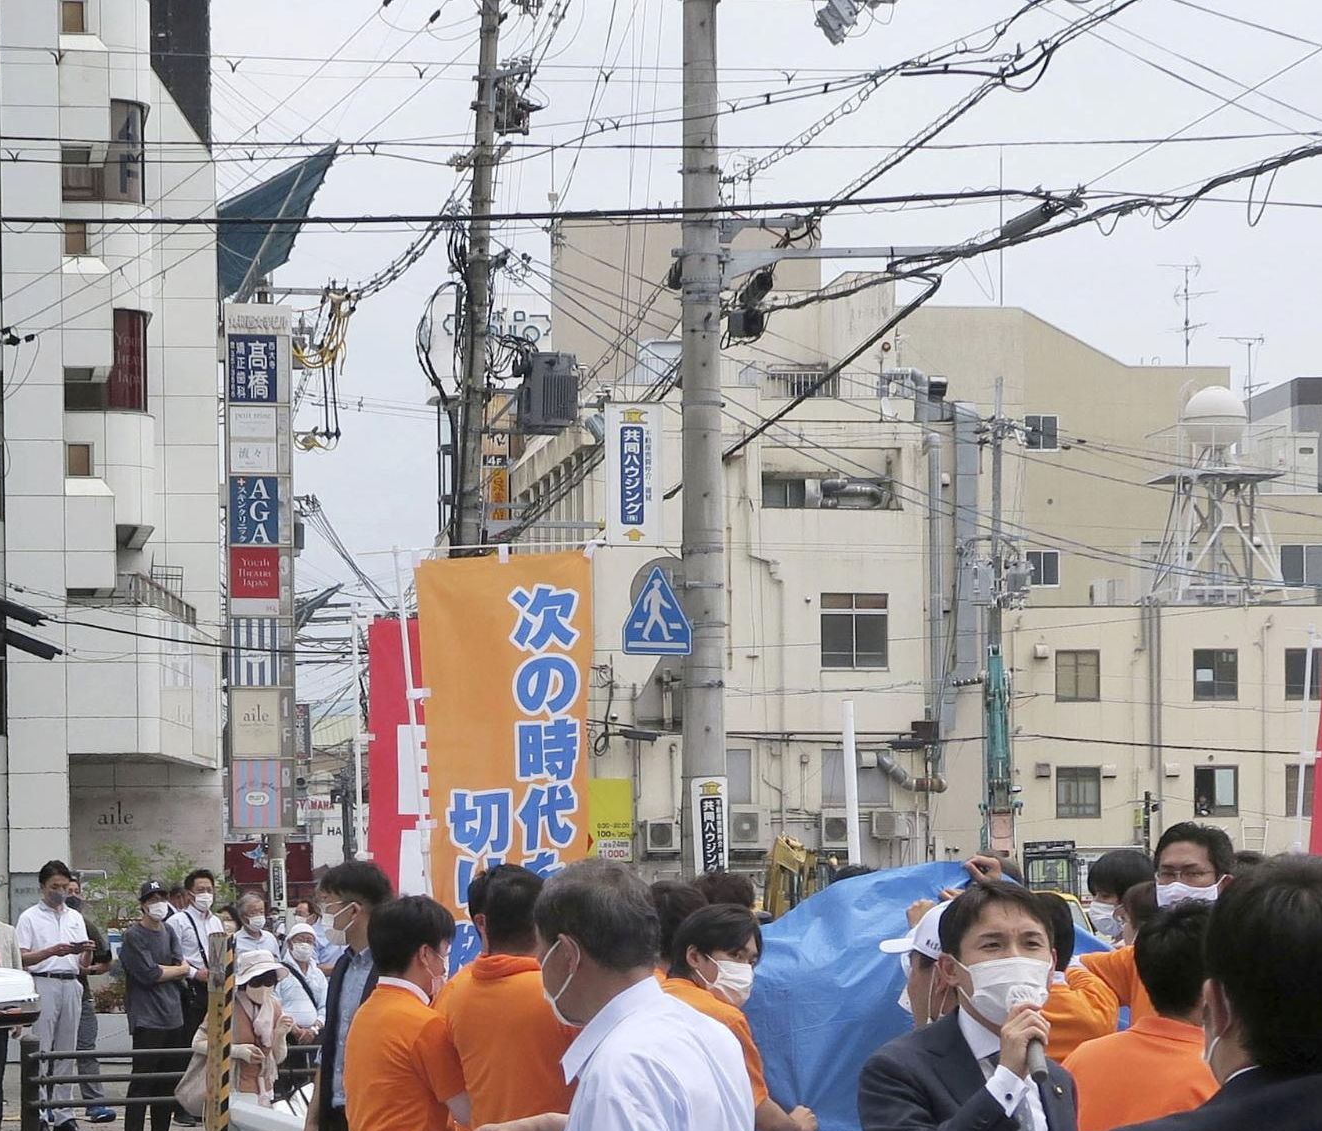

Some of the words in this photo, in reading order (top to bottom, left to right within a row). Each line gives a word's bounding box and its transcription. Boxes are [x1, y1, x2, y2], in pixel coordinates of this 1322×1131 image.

[236, 341, 245, 399] 矯正歯科
[488, 456, 502, 466] 4F
[237, 486, 247, 543] スキンクリニック
[249, 478, 272, 544] AGA
[243, 704, 269, 722] aile
[282, 697, 291, 743] 1F
[97, 800, 134, 825] aile
[703, 800, 717, 872] 共同ハウジング
